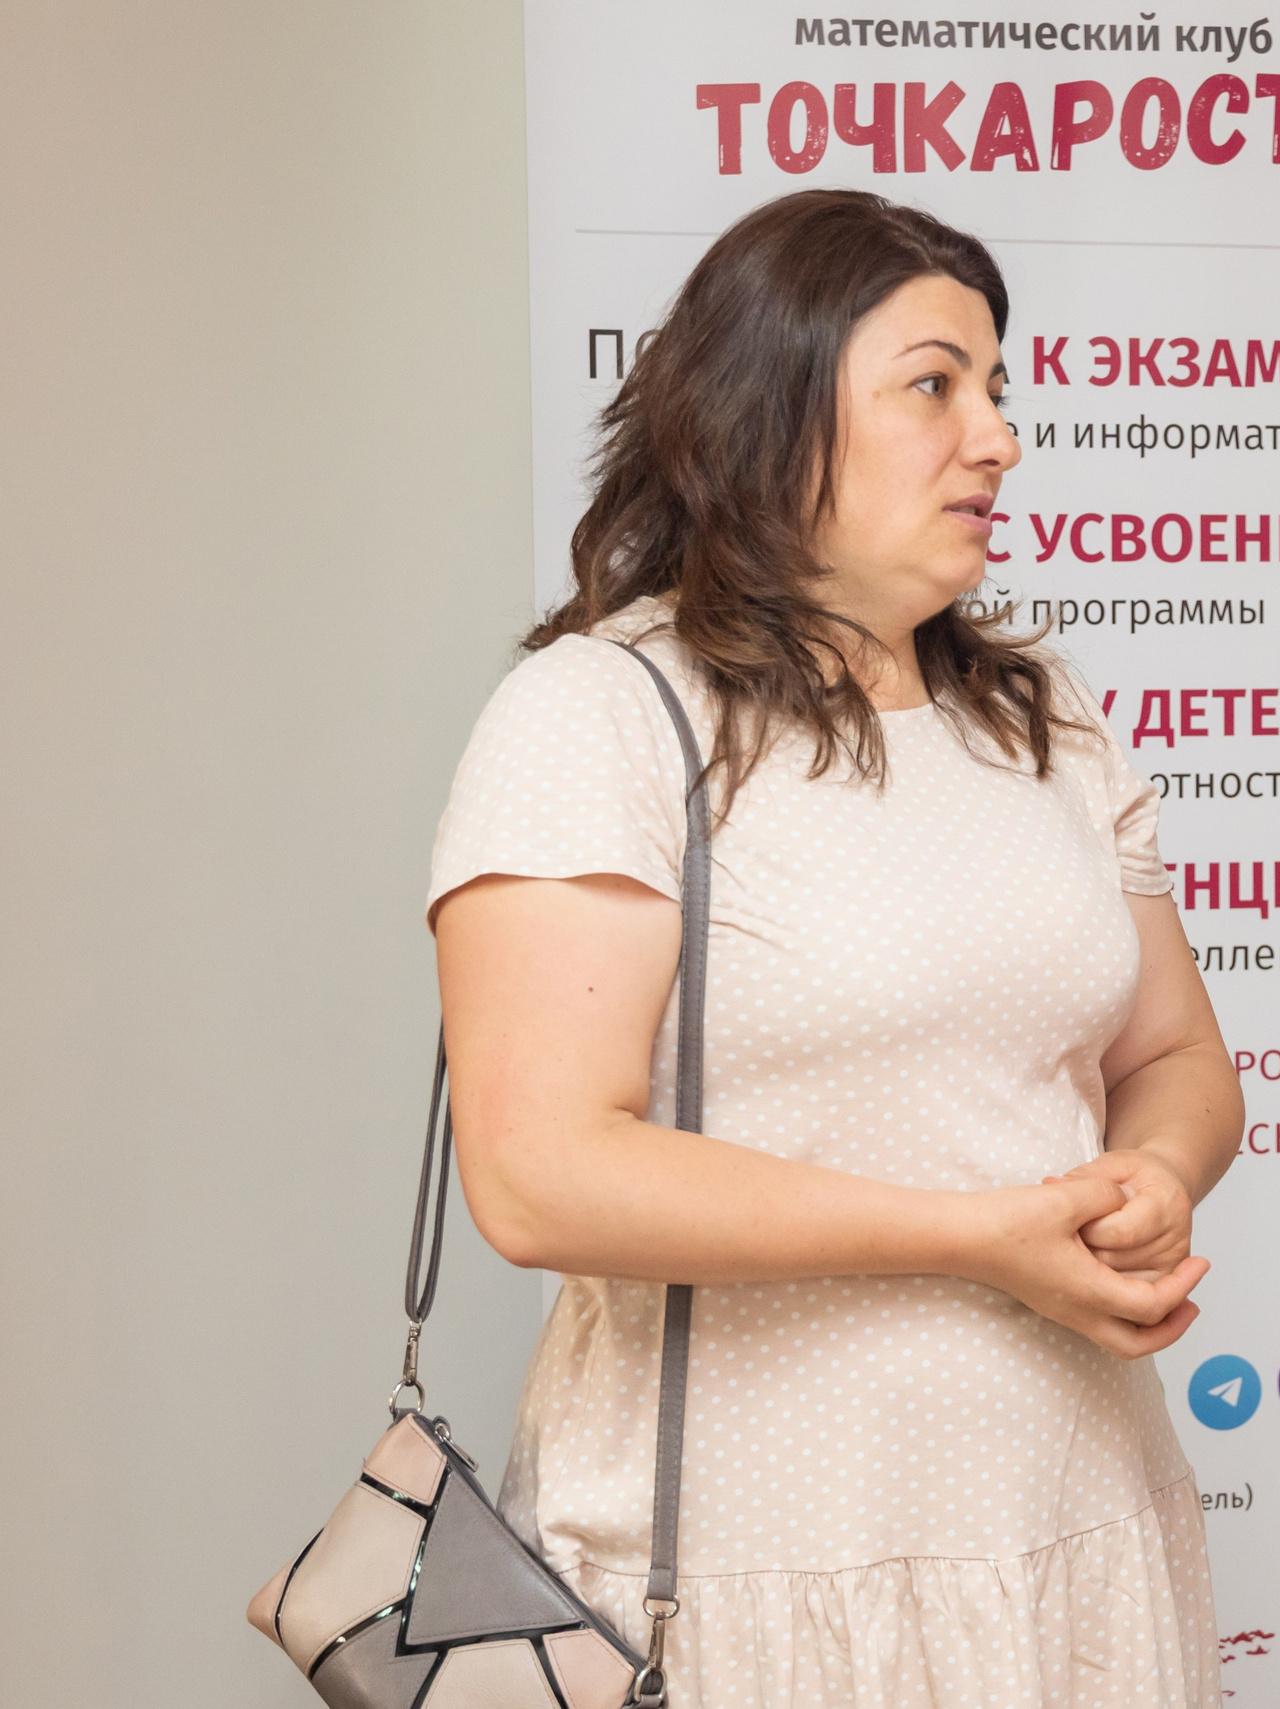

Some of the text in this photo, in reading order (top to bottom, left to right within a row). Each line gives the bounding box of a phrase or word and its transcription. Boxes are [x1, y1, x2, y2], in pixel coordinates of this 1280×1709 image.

[795, 12, 1273, 63] математический клуб
[1032, 336, 1071, 386] К
[1036, 422, 1056, 449] и
[1032, 599, 1265, 635] программы
